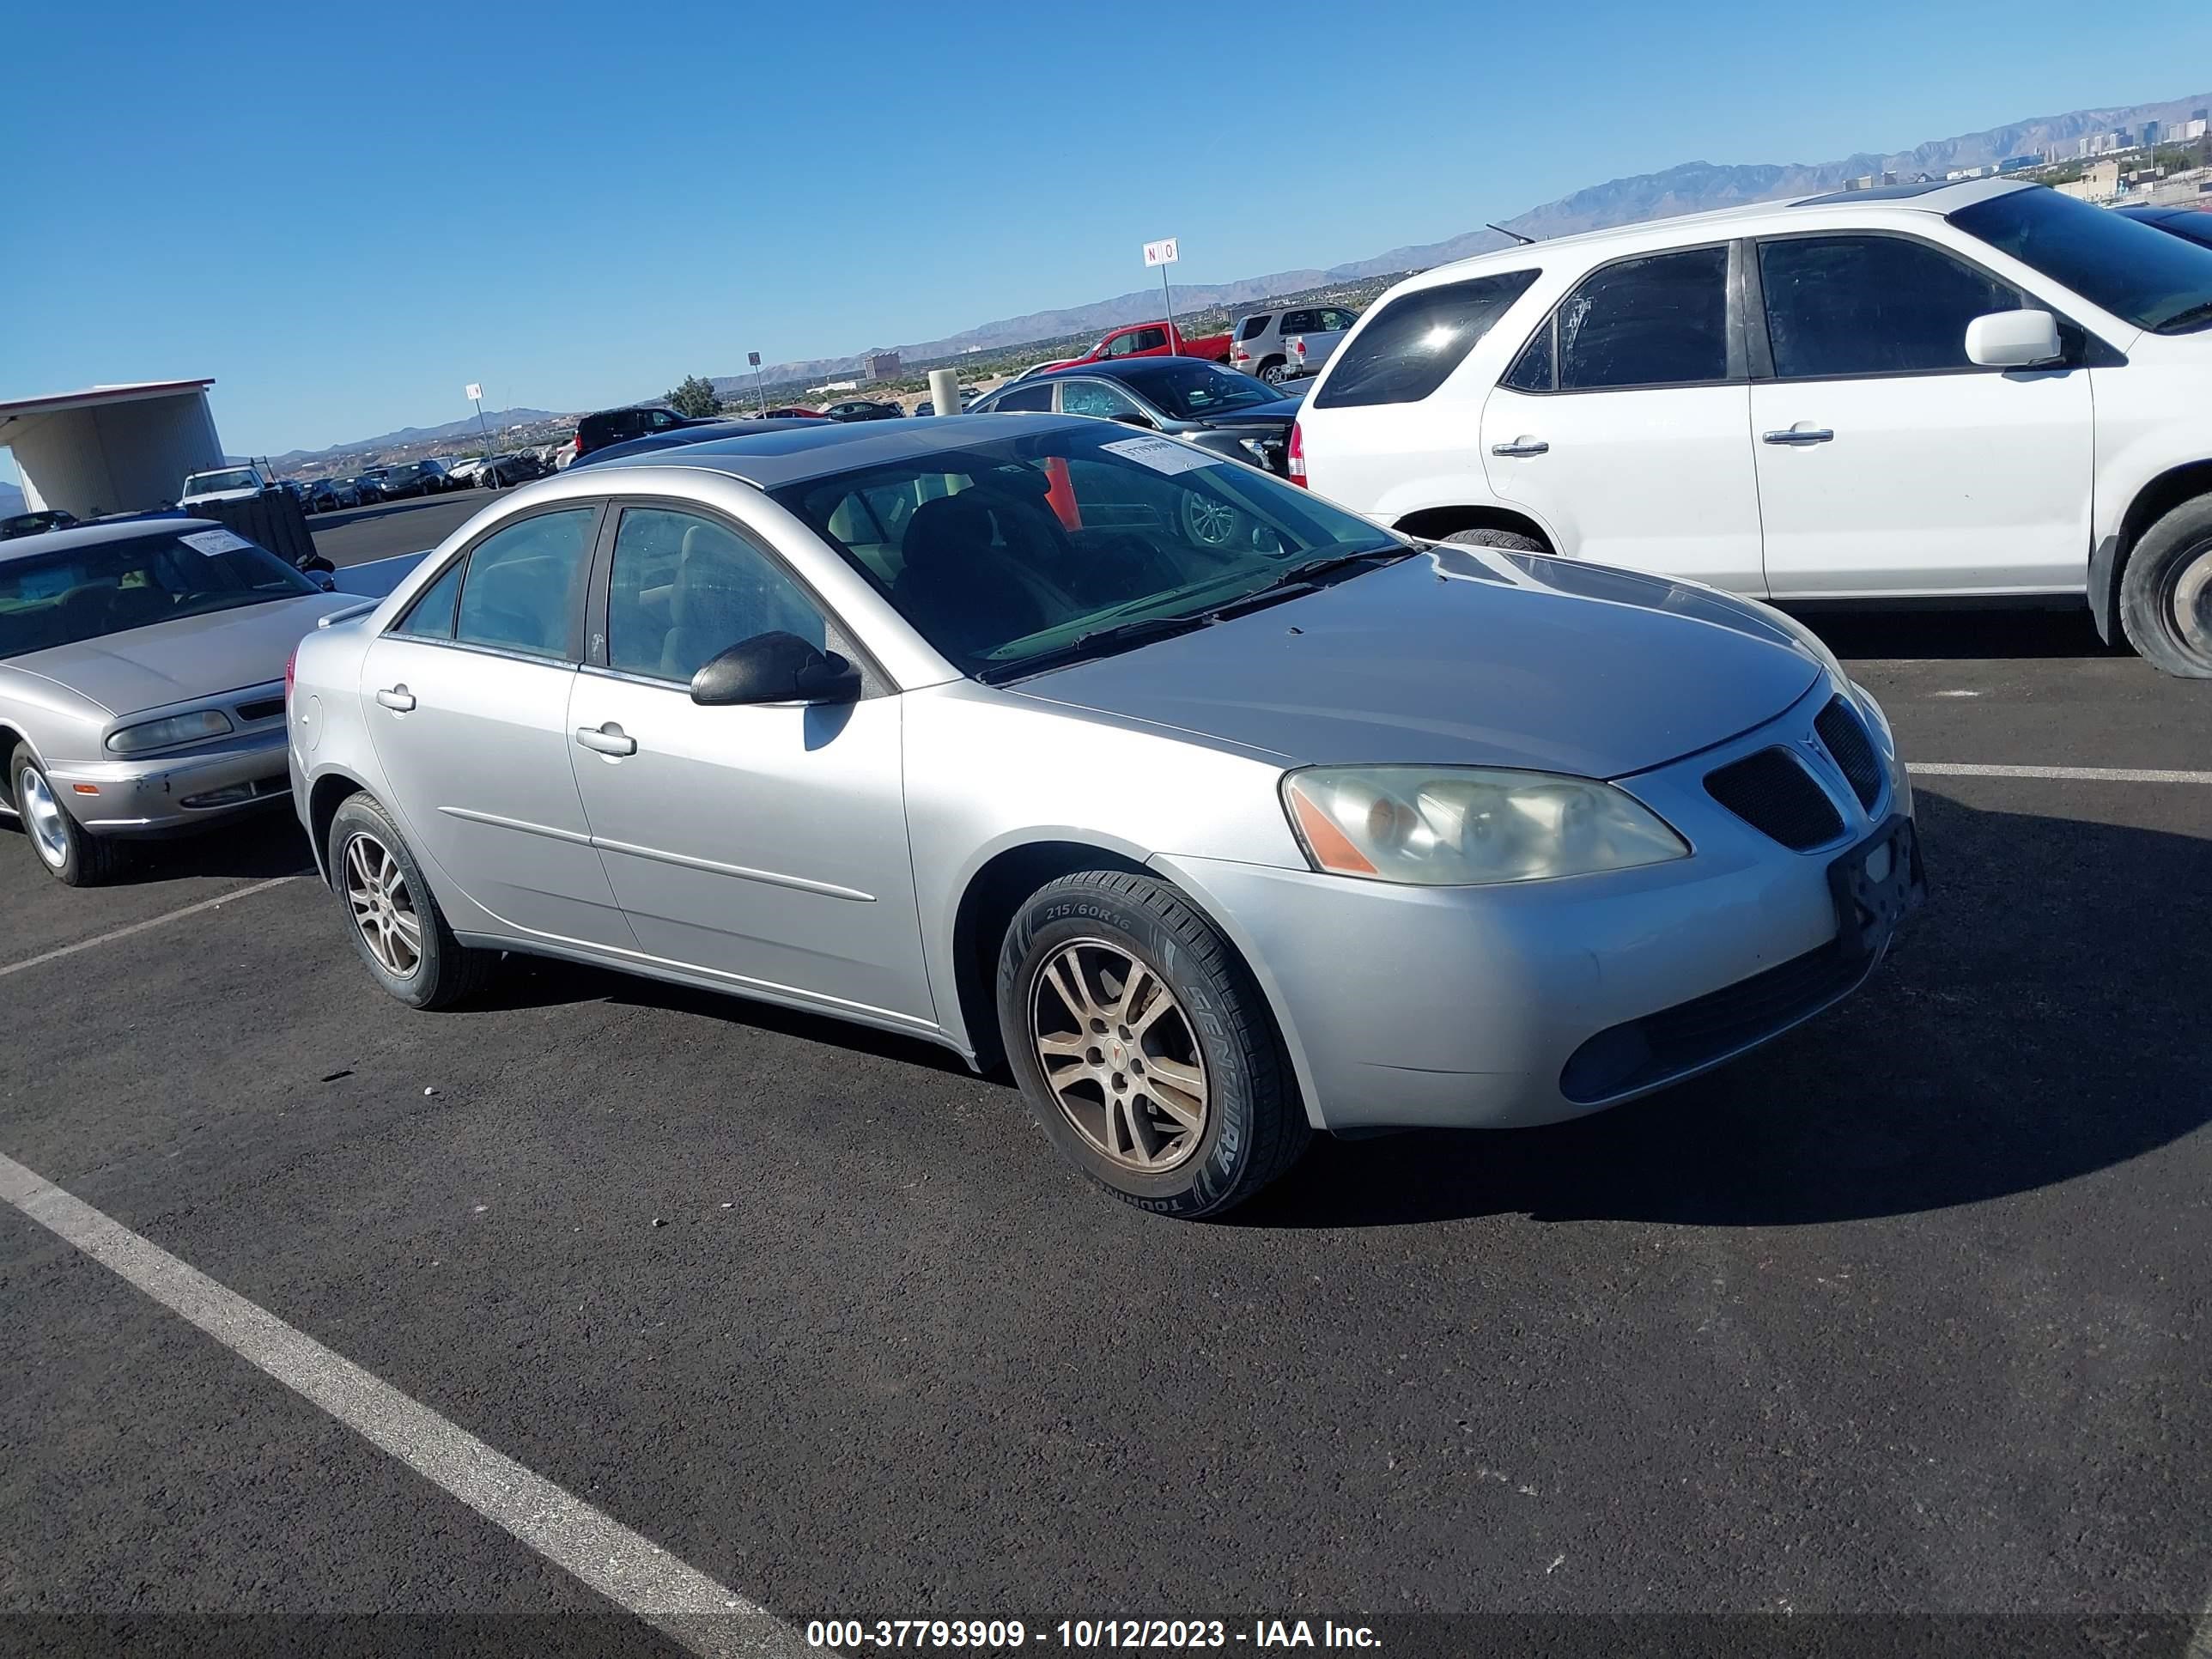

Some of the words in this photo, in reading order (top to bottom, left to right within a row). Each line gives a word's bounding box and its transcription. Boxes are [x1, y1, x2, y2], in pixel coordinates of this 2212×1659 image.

[1148, 247, 1156, 262] N
[1046, 902, 1132, 930] 215/60R16
[1182, 985, 1241, 1176] SENTURY
